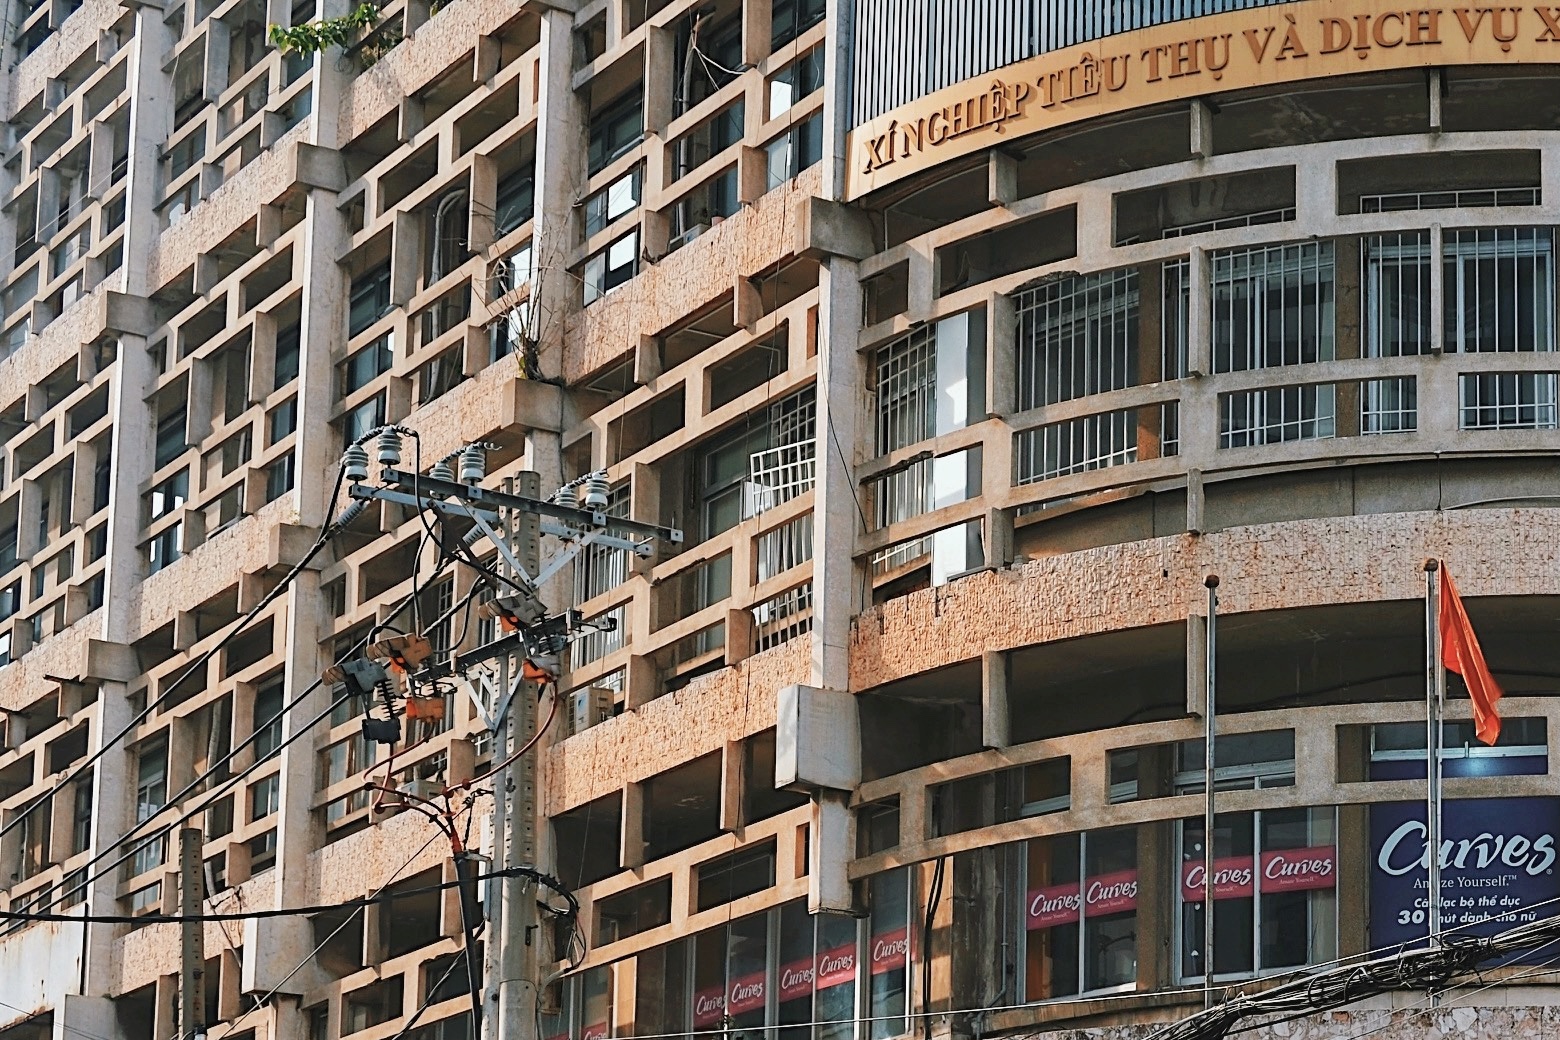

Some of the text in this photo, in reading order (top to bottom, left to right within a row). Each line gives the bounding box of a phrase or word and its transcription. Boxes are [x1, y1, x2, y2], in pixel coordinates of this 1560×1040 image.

[863, 119, 898, 175] XÍ
[901, 79, 1030, 159] NGHIỆP
[1036, 52, 1130, 109] TIÊU
[1140, 33, 1234, 83] THỤ
[1242, 15, 1308, 66] VÀ
[1320, 8, 1444, 60] DỊCH
[1455, 6, 1522, 52] VỤ
[1378, 820, 1556, 876] Curves
[1266, 856, 1332, 880] Curves
[1086, 881, 1137, 904] Curves
[1460, 896, 1474, 909] bộ
[1478, 895, 1498, 906] thể
[1500, 895, 1521, 907] dục
[1030, 894, 1080, 917] Curves
[1398, 910, 1425, 924] 30
[1460, 911, 1490, 923] dành
[1520, 911, 1538, 922] nữ
[820, 954, 853, 977] Curves
[782, 967, 814, 990] Curves
[731, 982, 763, 1003] Curves
